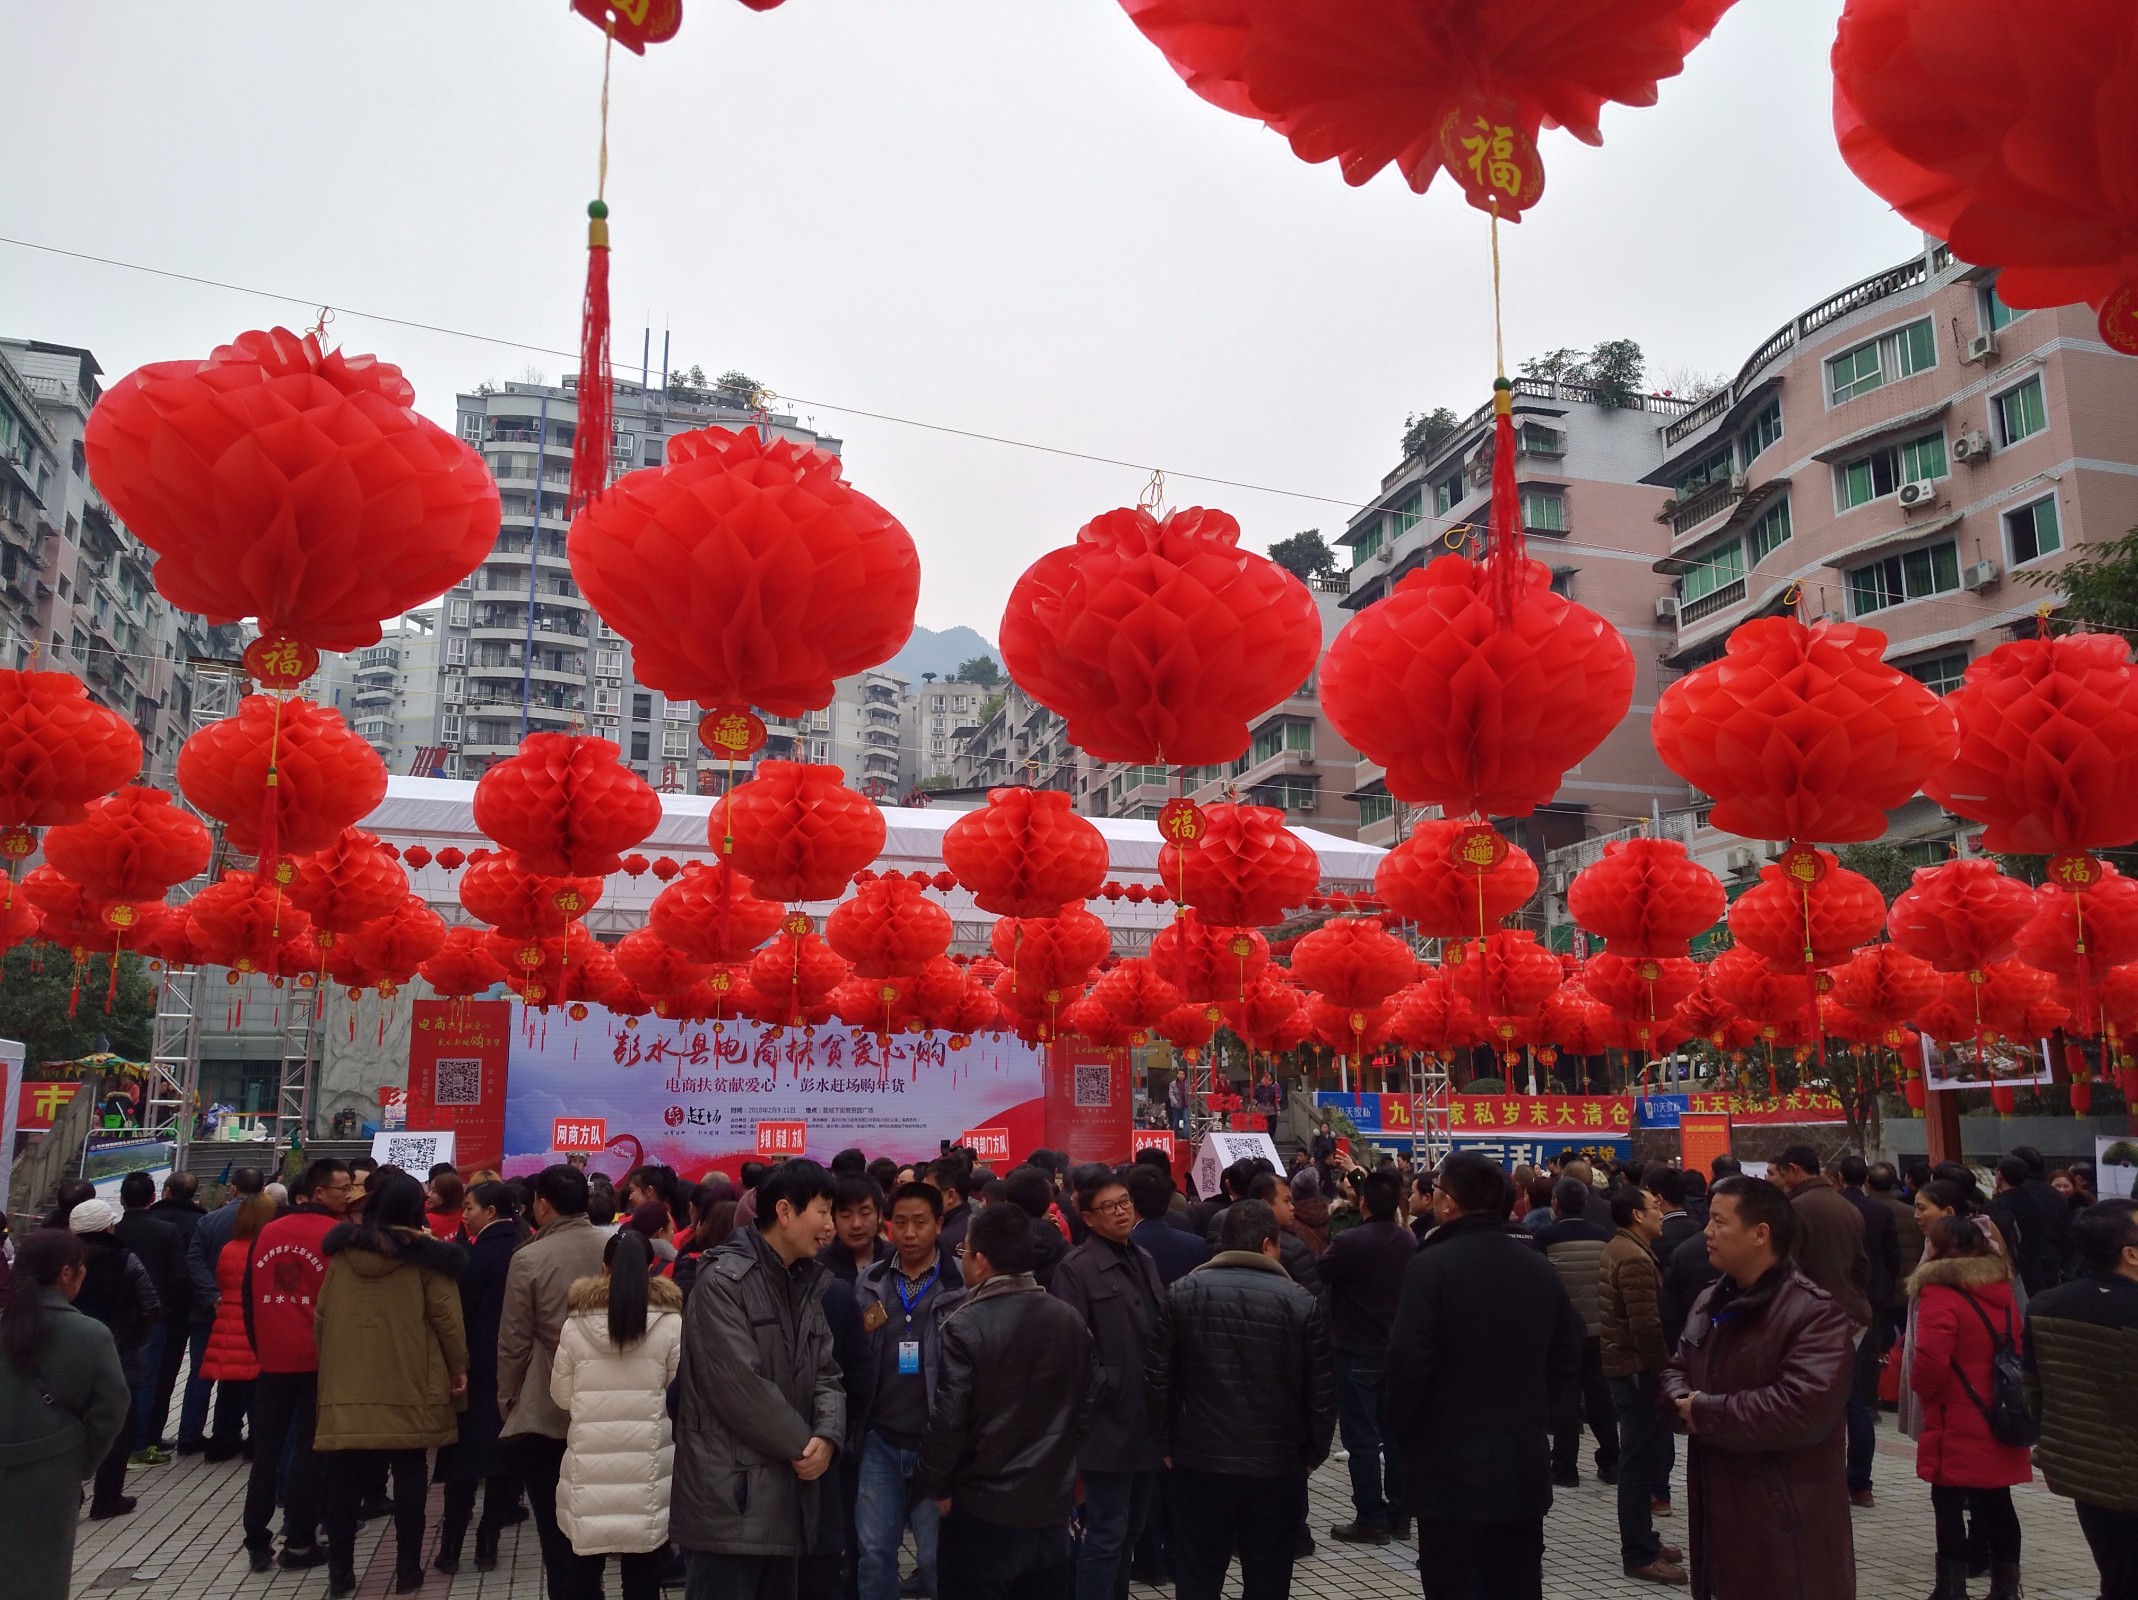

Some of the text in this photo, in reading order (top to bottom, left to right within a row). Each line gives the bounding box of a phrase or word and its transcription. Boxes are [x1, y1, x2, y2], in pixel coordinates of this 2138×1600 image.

[1460, 115, 1521, 196] 福
[261, 642, 302, 676] 福
[1169, 809, 1196, 839] 福
[5, 834, 29, 854] 福
[2059, 857, 2090, 883] 福
[559, 893, 579, 911] 福
[789, 917, 806, 934] 福
[318, 930, 333, 948] 福
[520, 949, 539, 965] 福
[1448, 946, 1461, 965] 福
[379, 978, 390, 989] 福
[711, 973, 729, 990] 福
[1970, 969, 1982, 983] 福
[527, 986, 540, 999] 福
[573, 1009, 584, 1018] 福
[1133, 1033, 1145, 1044] 福
[1888, 1028, 1900, 1043] 福
[1542, 1052, 1553, 1063] 福
[665, 1077, 905, 1093] 电商扶贫献爱心 彭水赶场购年货
[556, 1124, 602, 1146] 网商方队
